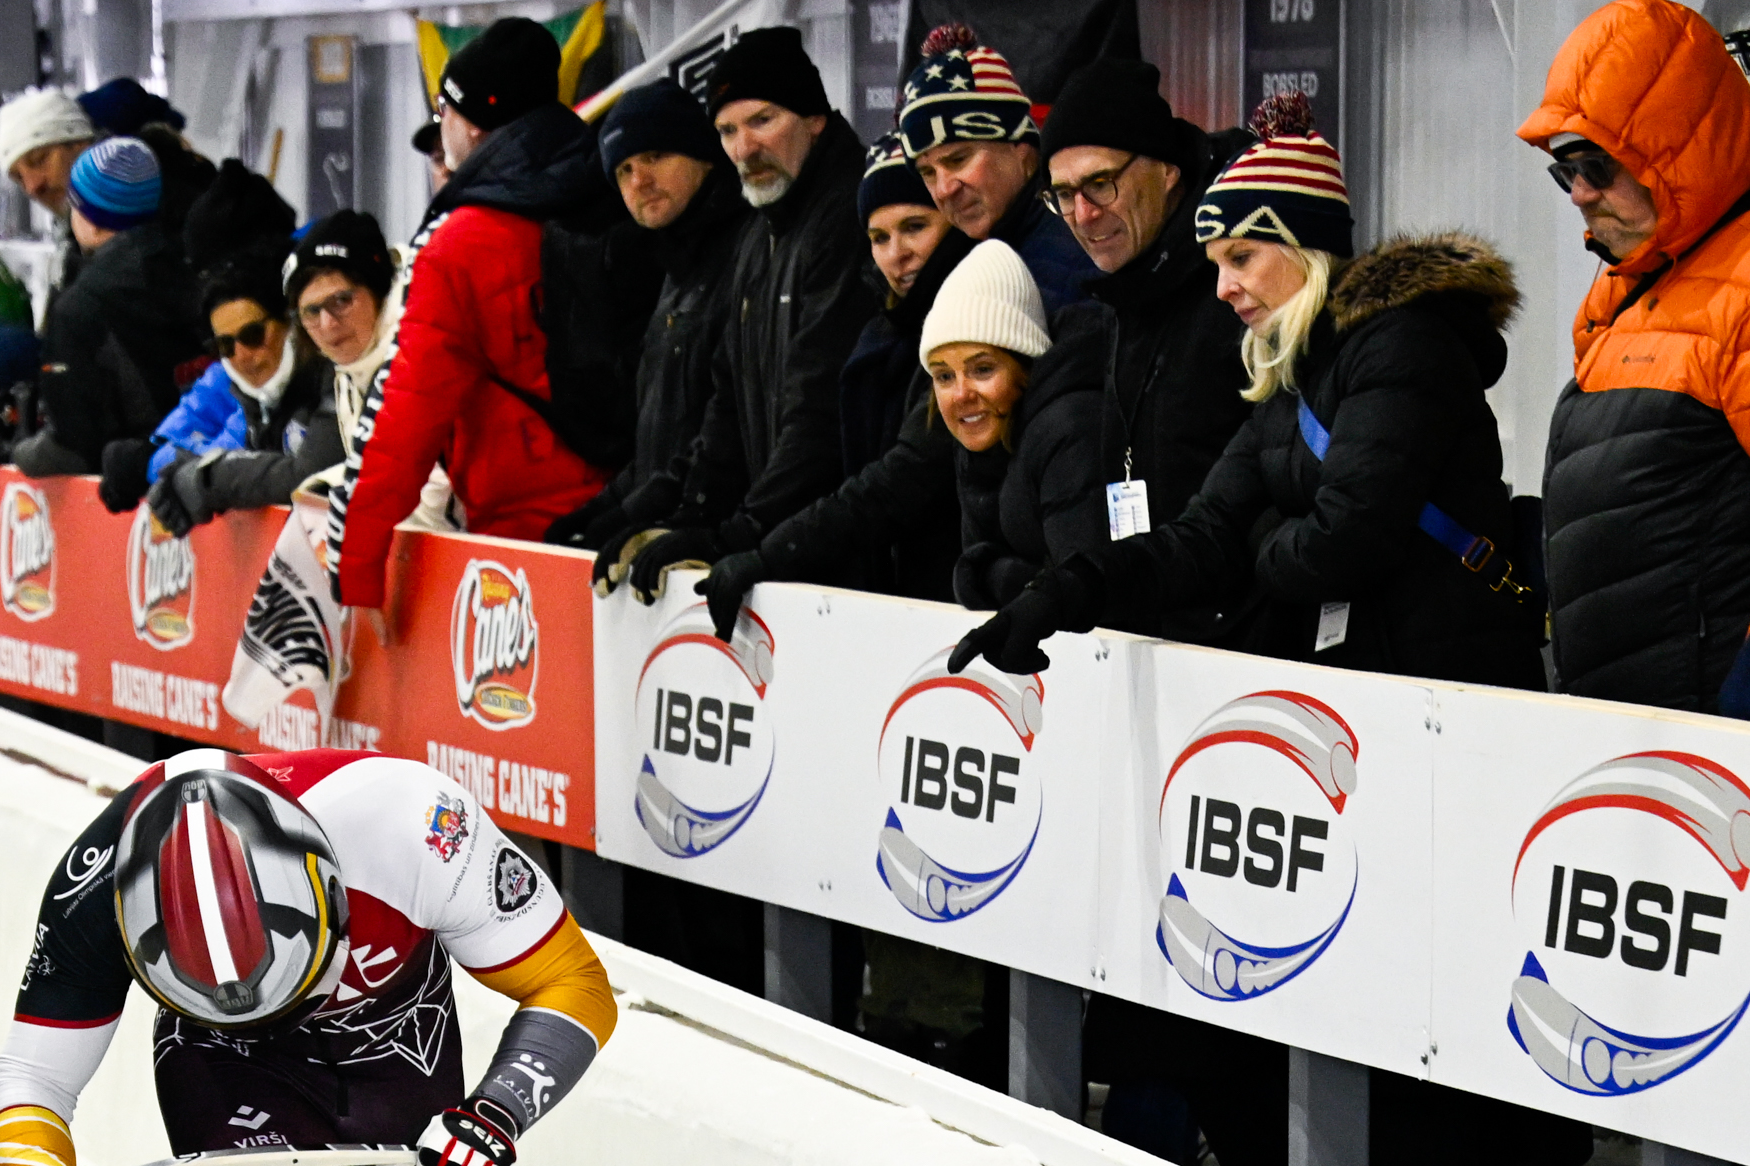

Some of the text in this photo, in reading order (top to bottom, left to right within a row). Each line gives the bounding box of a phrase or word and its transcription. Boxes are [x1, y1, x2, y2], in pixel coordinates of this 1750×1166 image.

[901, 111, 1041, 159] USA
[1195, 203, 1301, 252] SA
[454, 560, 536, 707] Cane's
[110, 660, 220, 733] RAISING CANE'S
[652, 687, 755, 767] IBSF
[498, 759, 567, 828] CANE'S
[899, 735, 1022, 824] IBSF
[465, 851, 473, 865] un
[1183, 794, 1331, 894] IBSF
[1543, 863, 1729, 978] IBSF
[234, 1131, 288, 1148] VIRŠI
[458, 1119, 507, 1158] SEIZ
